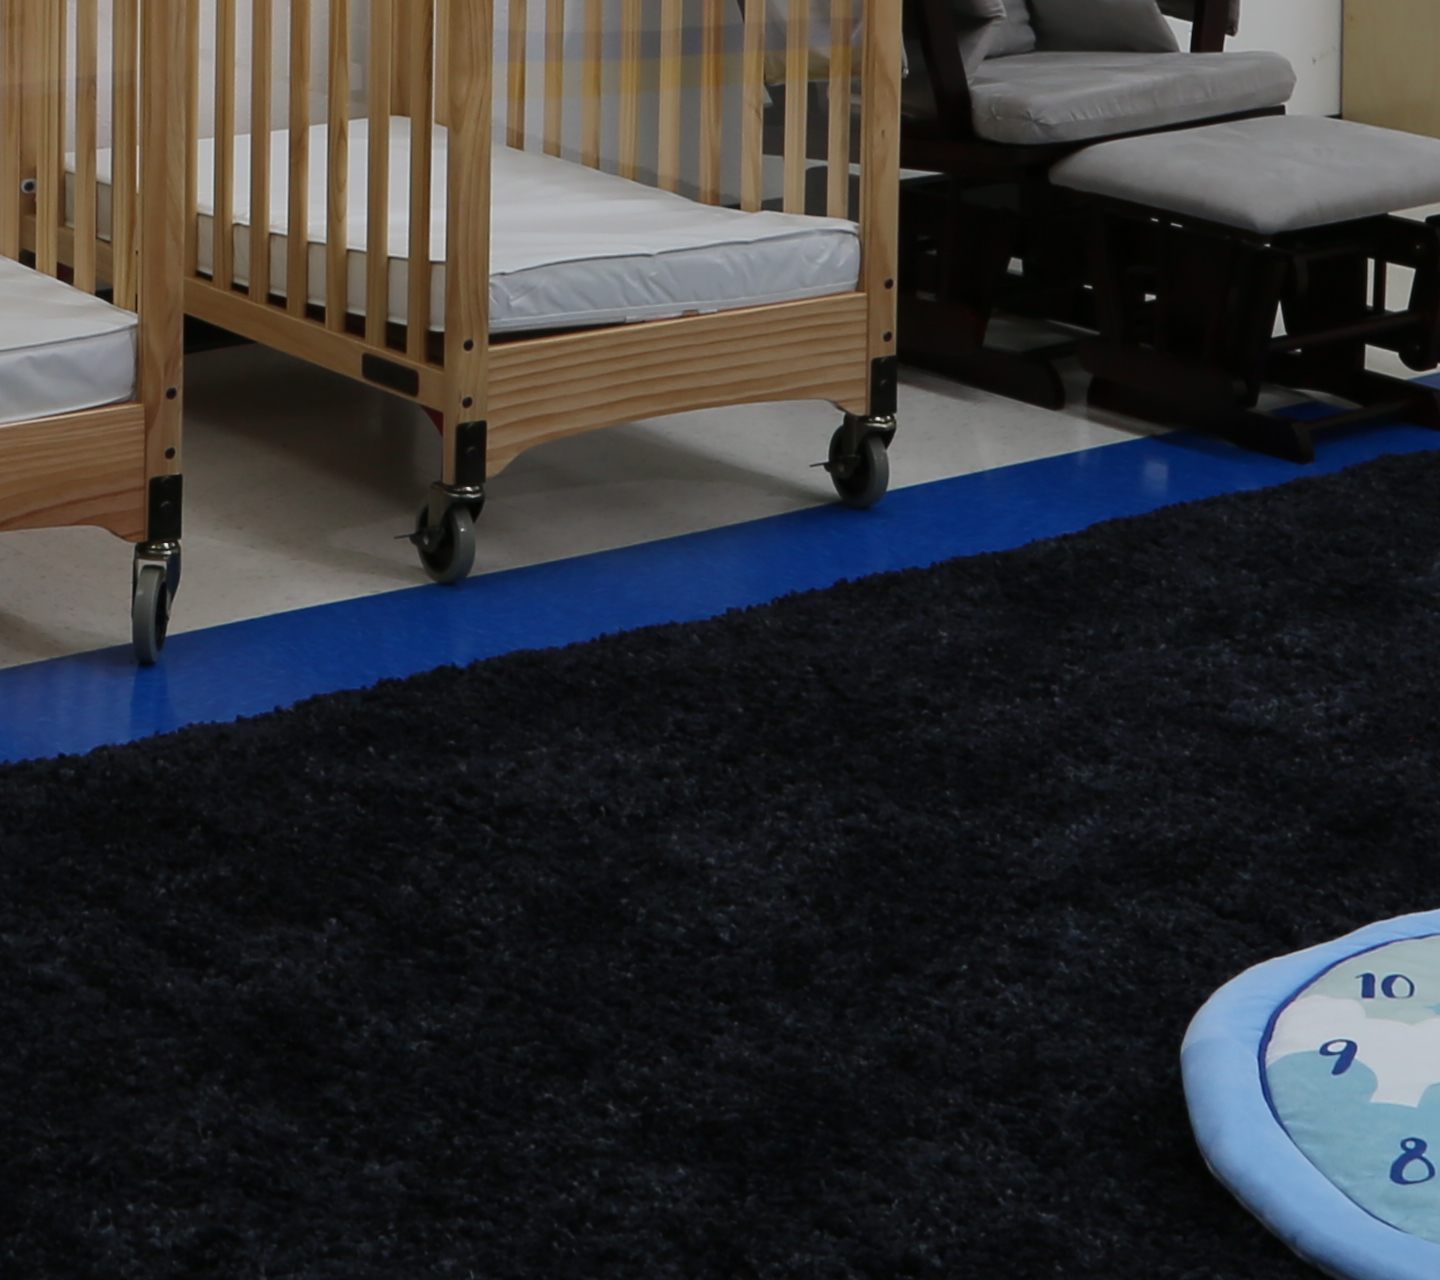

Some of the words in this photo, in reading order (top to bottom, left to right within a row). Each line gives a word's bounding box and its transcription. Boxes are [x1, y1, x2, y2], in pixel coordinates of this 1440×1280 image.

[1355, 972, 1415, 1000] 10
[1321, 1039, 1358, 1076] 9
[1389, 1137, 1436, 1185] 8
